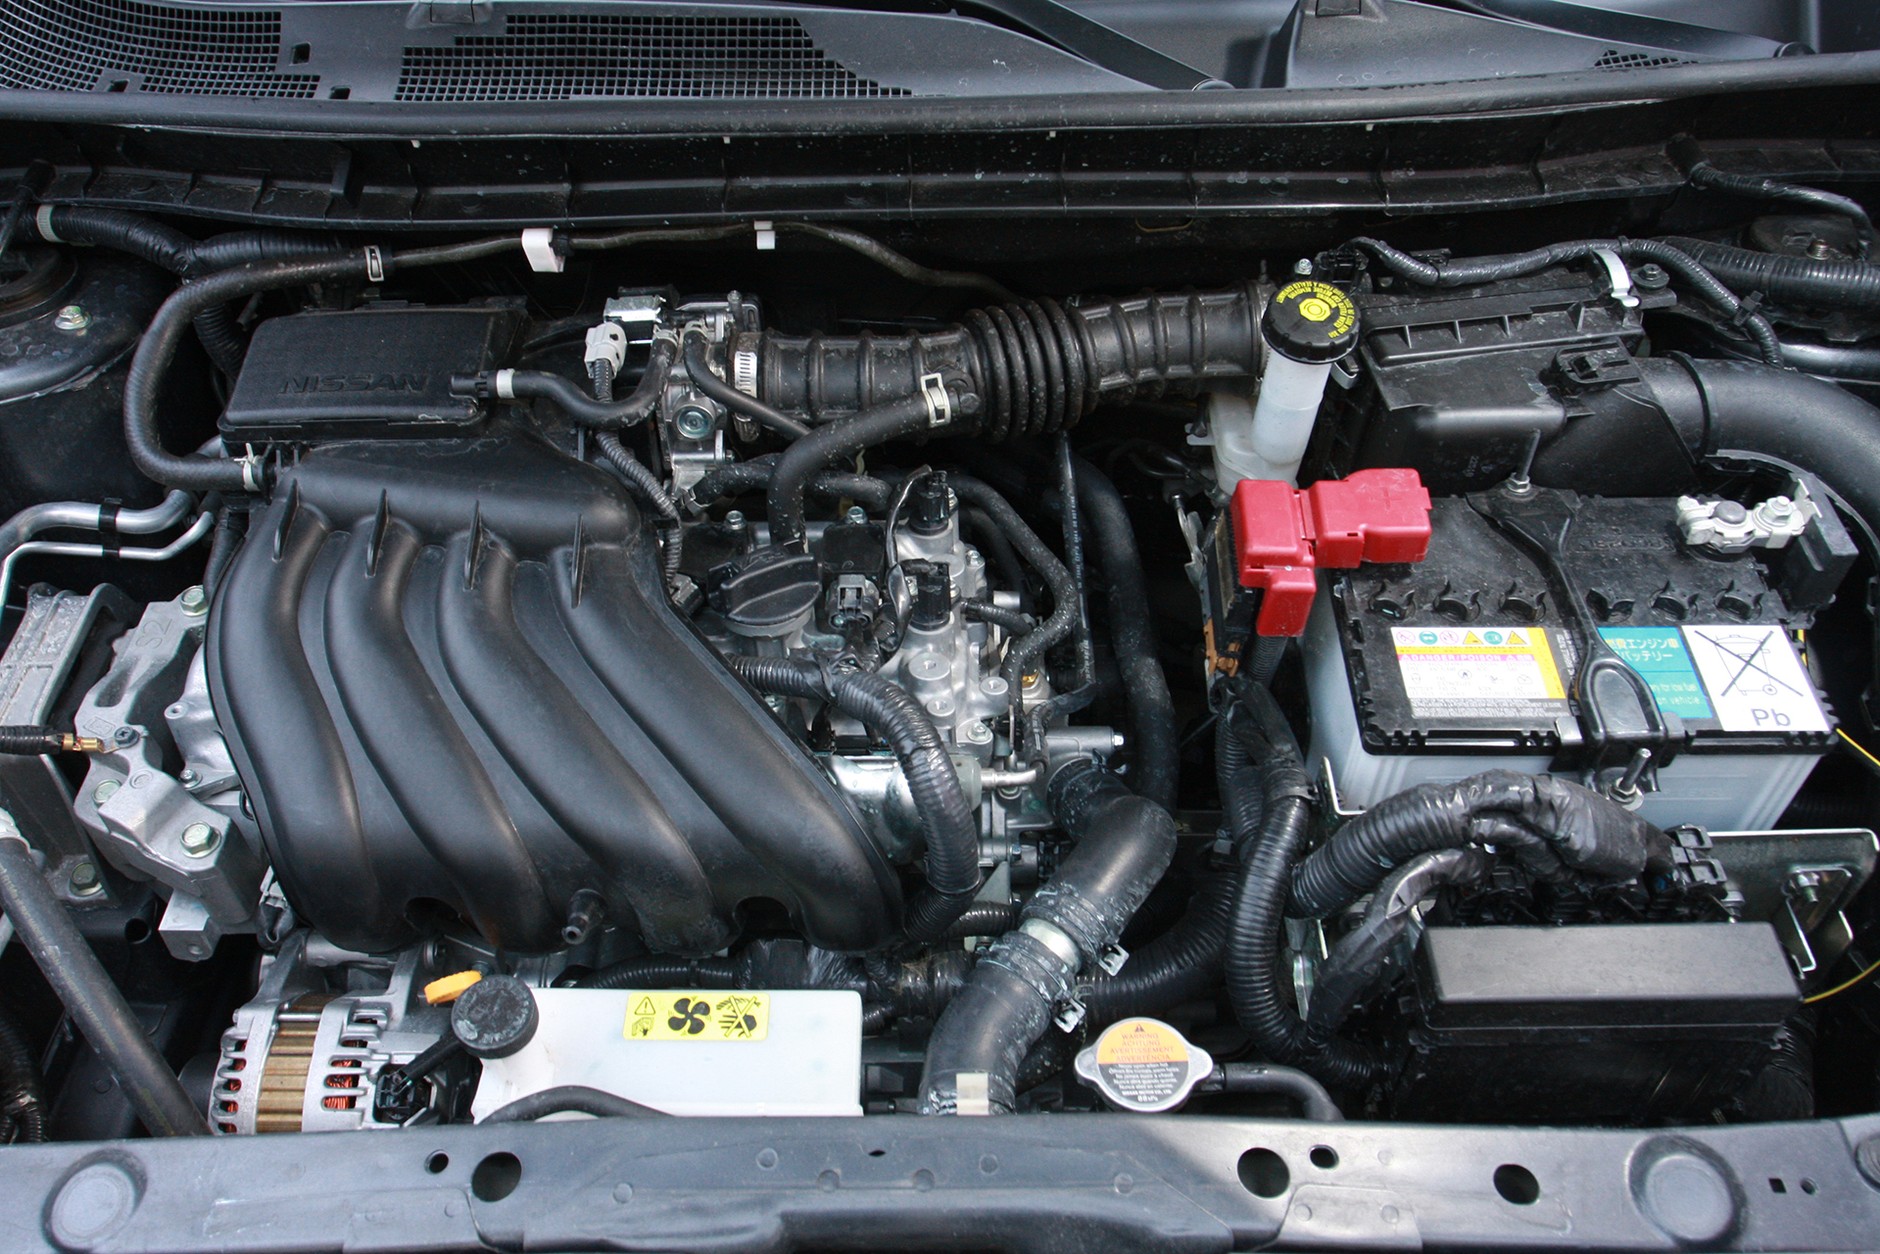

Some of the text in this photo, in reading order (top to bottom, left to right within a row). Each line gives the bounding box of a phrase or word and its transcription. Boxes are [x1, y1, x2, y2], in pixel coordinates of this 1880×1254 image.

[278, 374, 428, 394] NISSAN
[1751, 708, 1790, 726] Pb
[1111, 1046, 1174, 1054] AVERTISSEMENT
